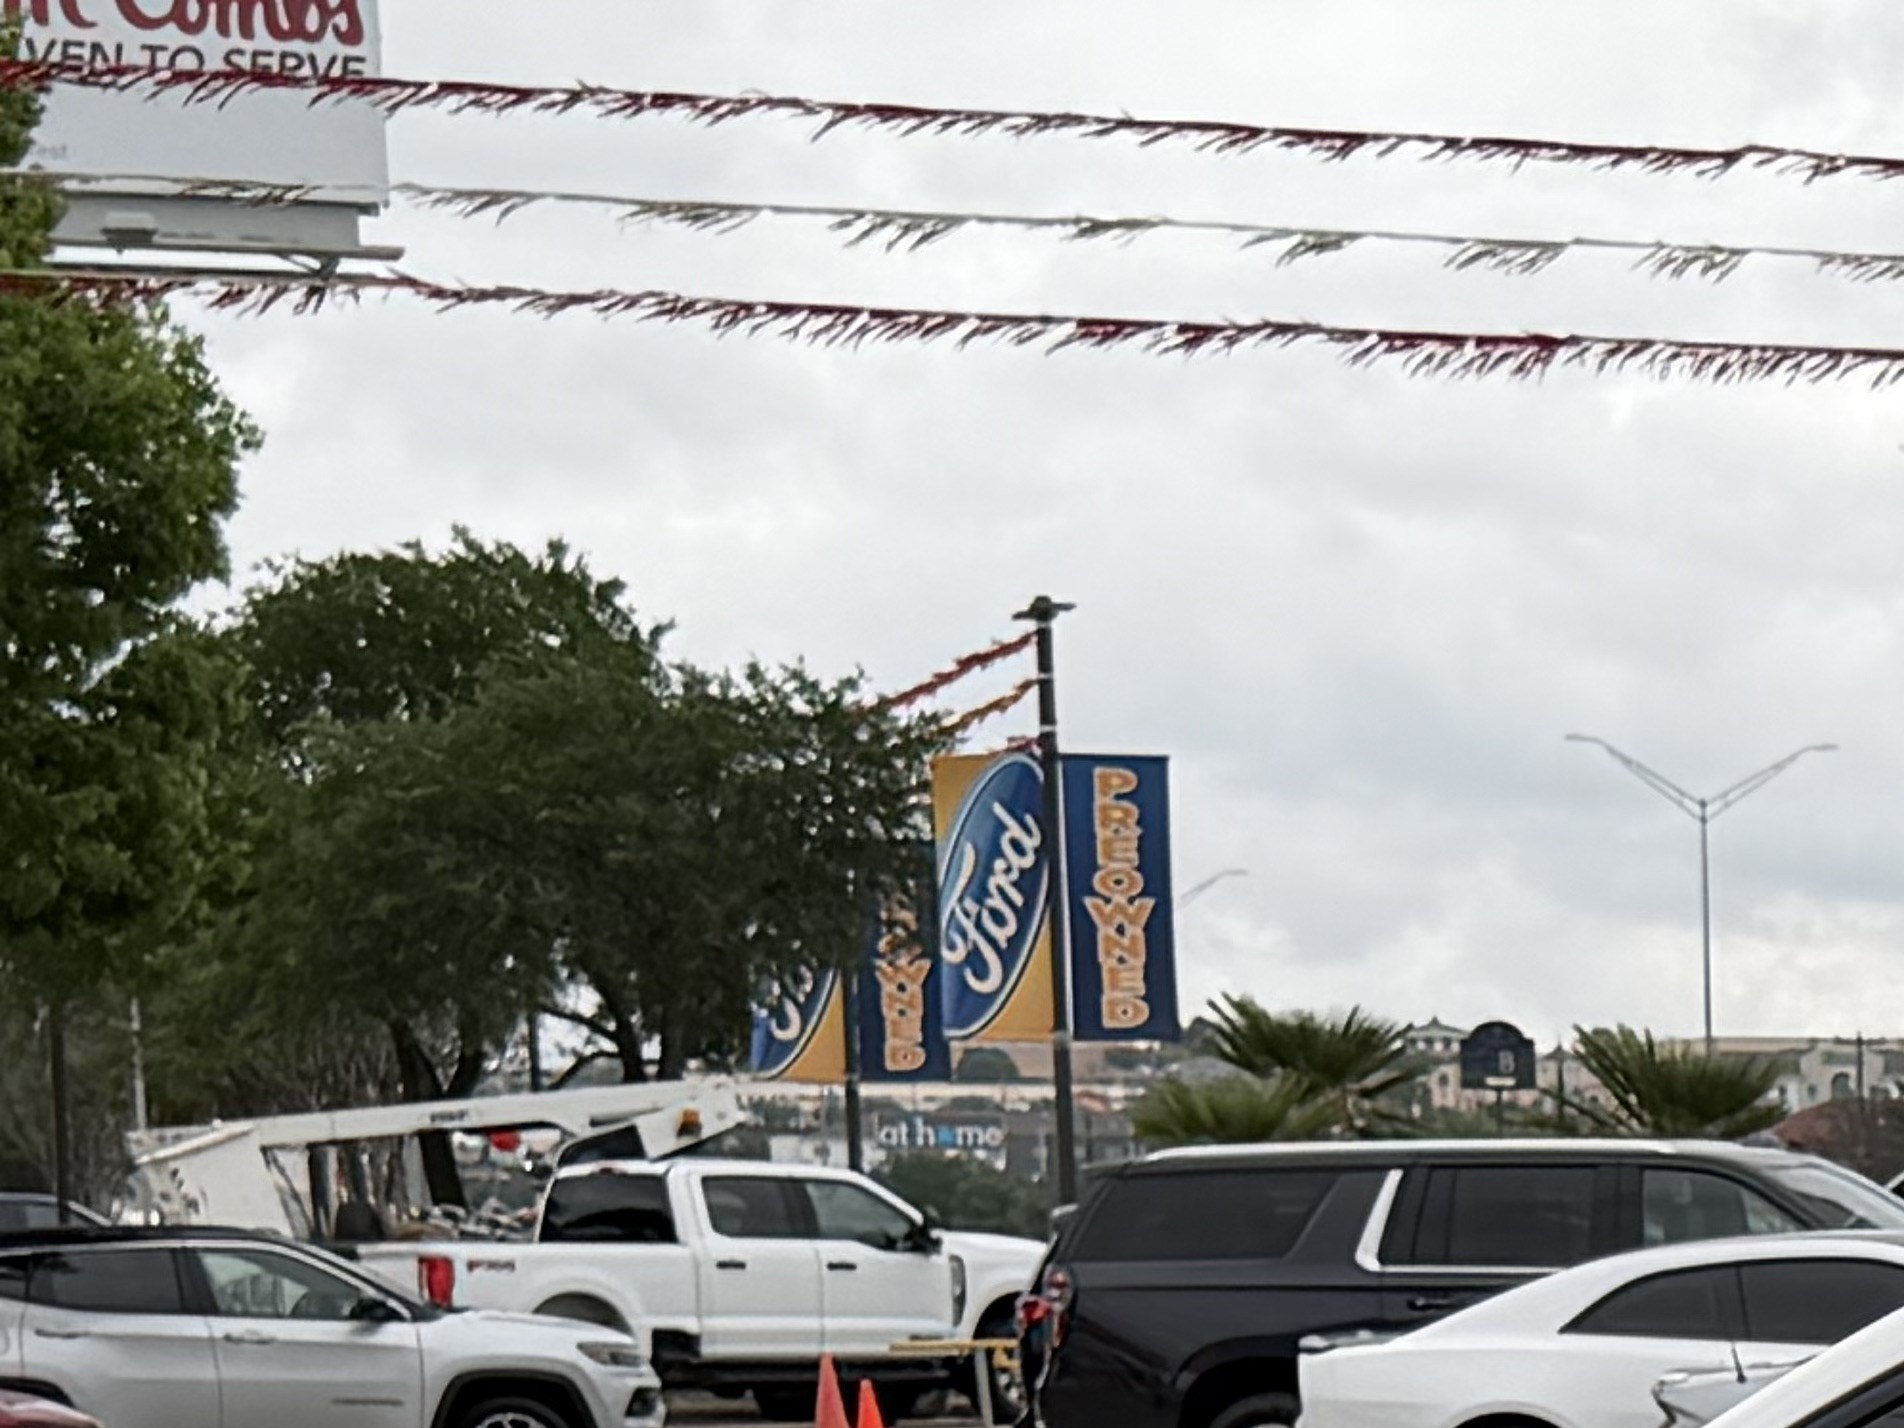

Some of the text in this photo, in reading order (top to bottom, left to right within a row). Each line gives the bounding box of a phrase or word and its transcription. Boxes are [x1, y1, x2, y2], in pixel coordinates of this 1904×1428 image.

[141, 44, 205, 76] TO
[222, 47, 366, 80] SERVE
[942, 802, 1041, 994] Ford
[1082, 767, 1156, 1029] PREOWNED
